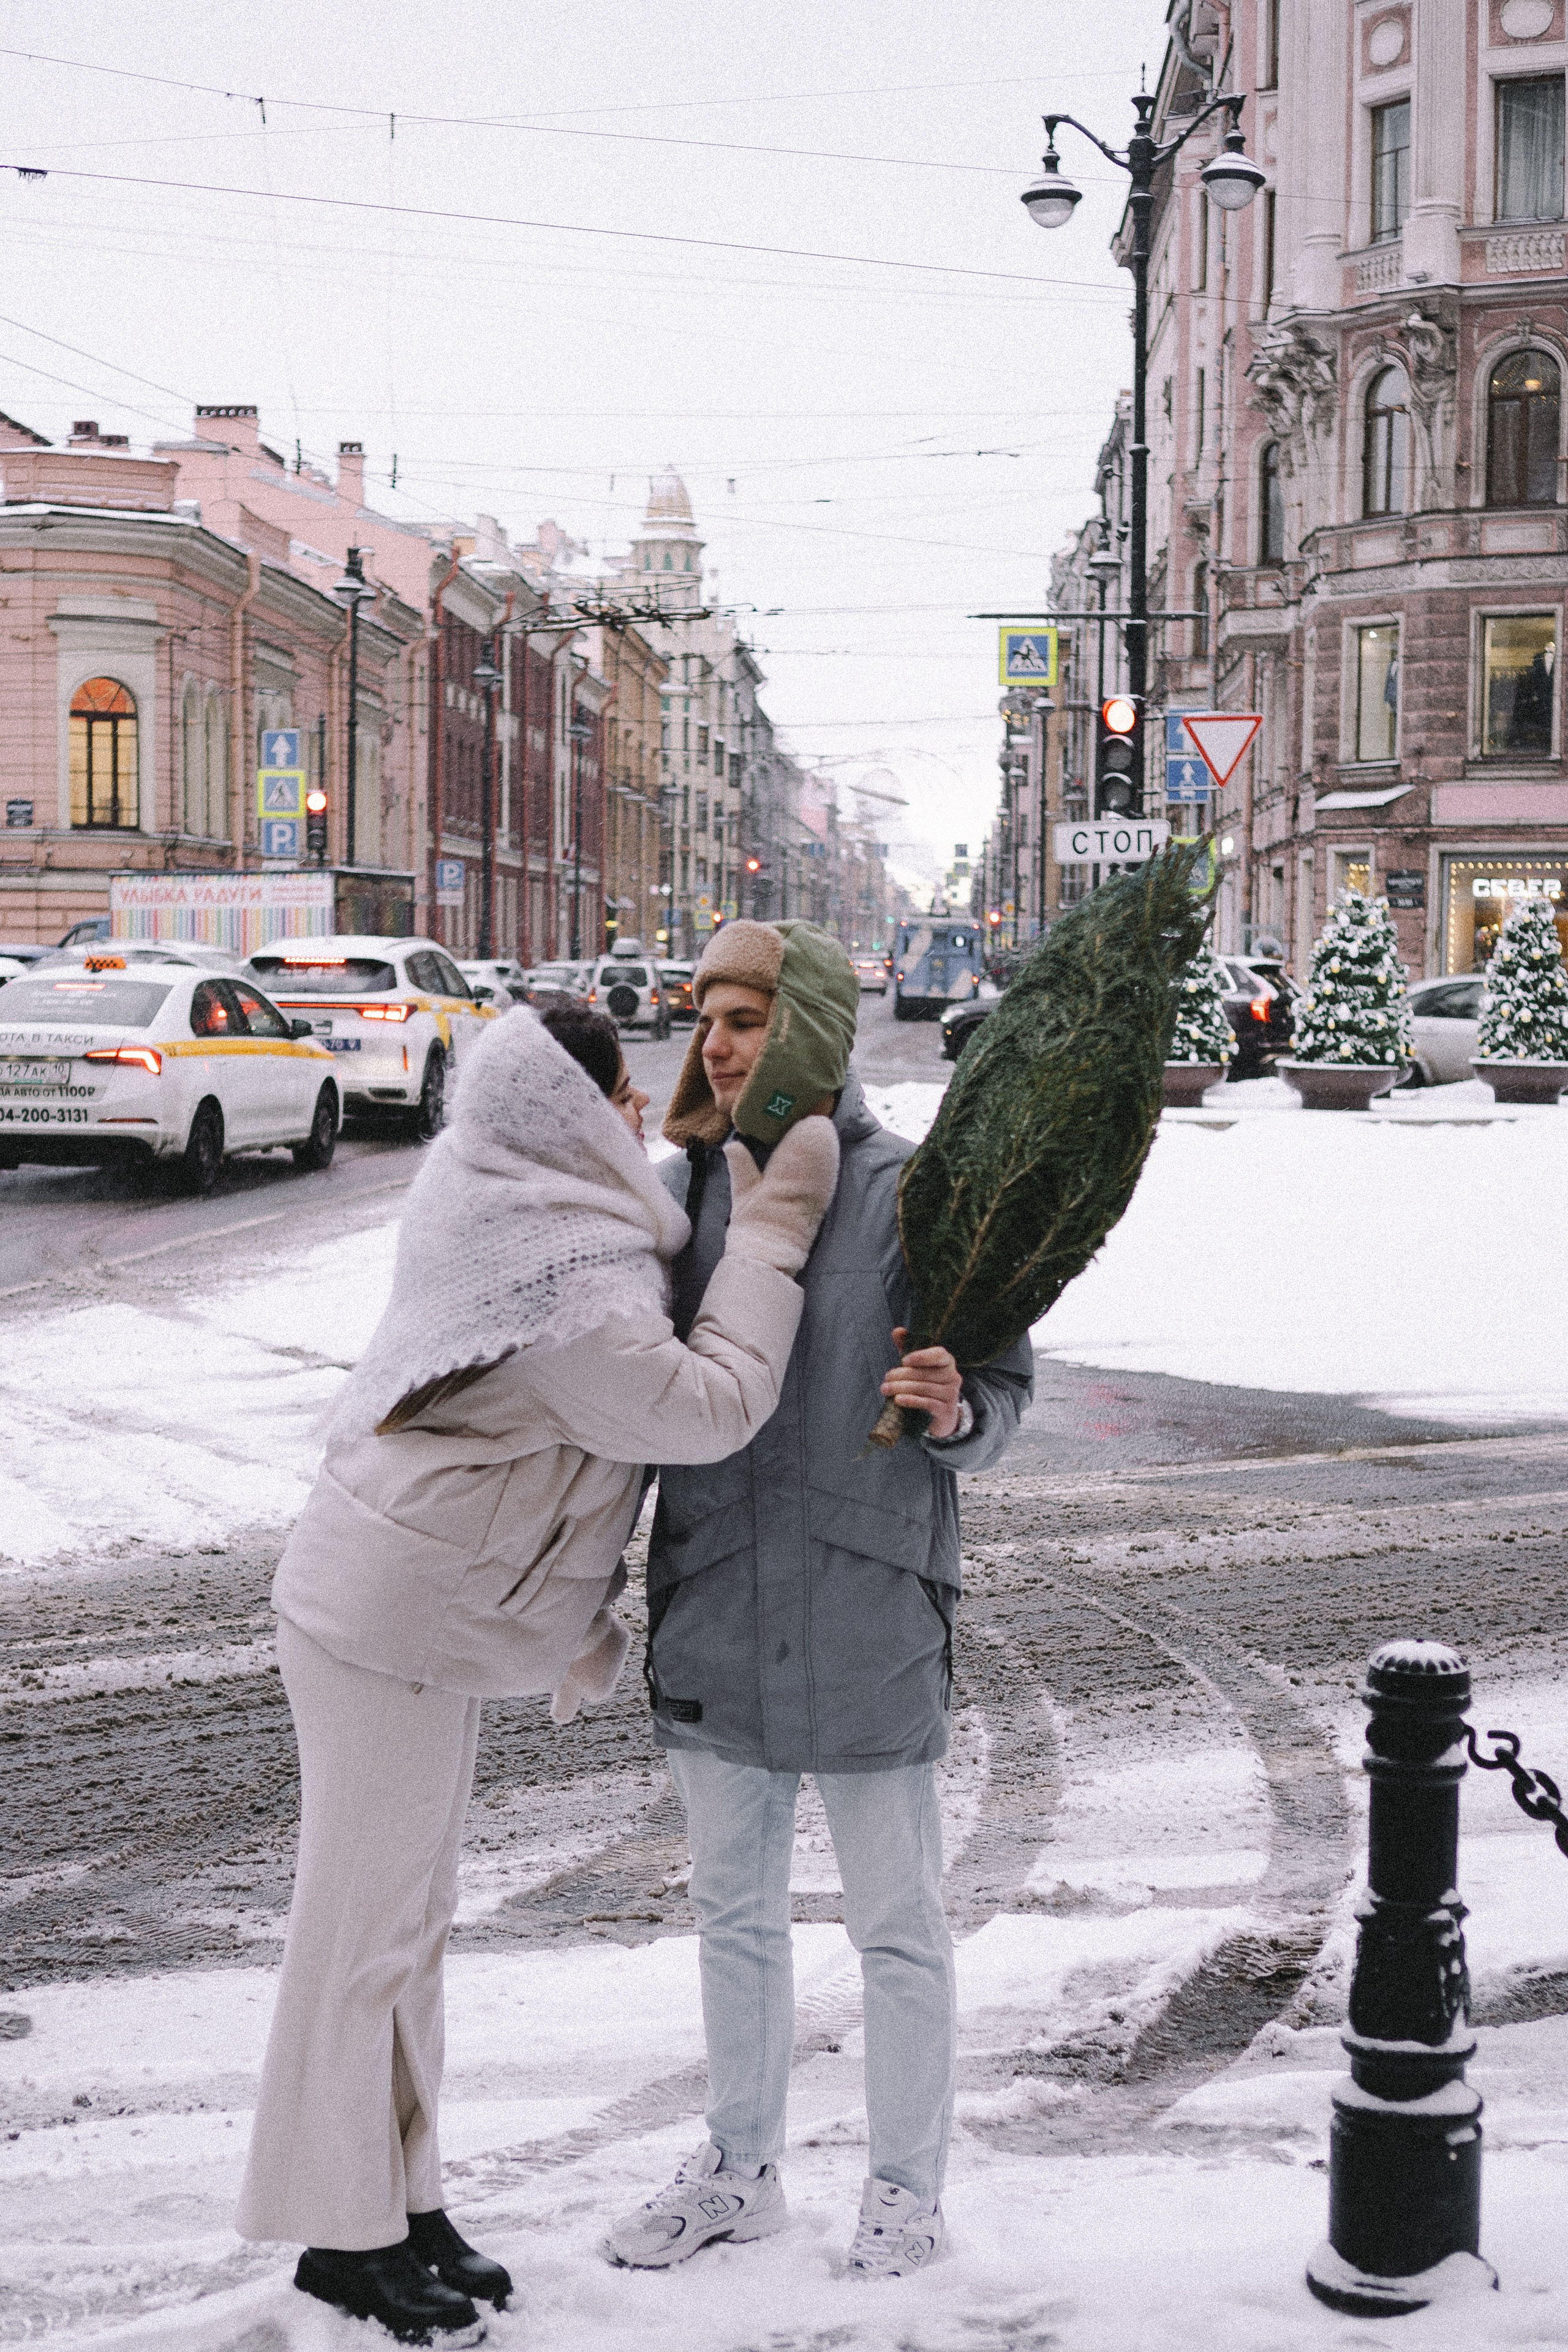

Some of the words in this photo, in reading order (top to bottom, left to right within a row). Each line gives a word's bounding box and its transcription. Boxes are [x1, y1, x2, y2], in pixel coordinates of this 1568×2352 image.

[1072, 829, 1153, 854] СТОП
[48, 1034, 94, 1046] ТАКСИ
[14, 1088, 40, 1096] АВТО
